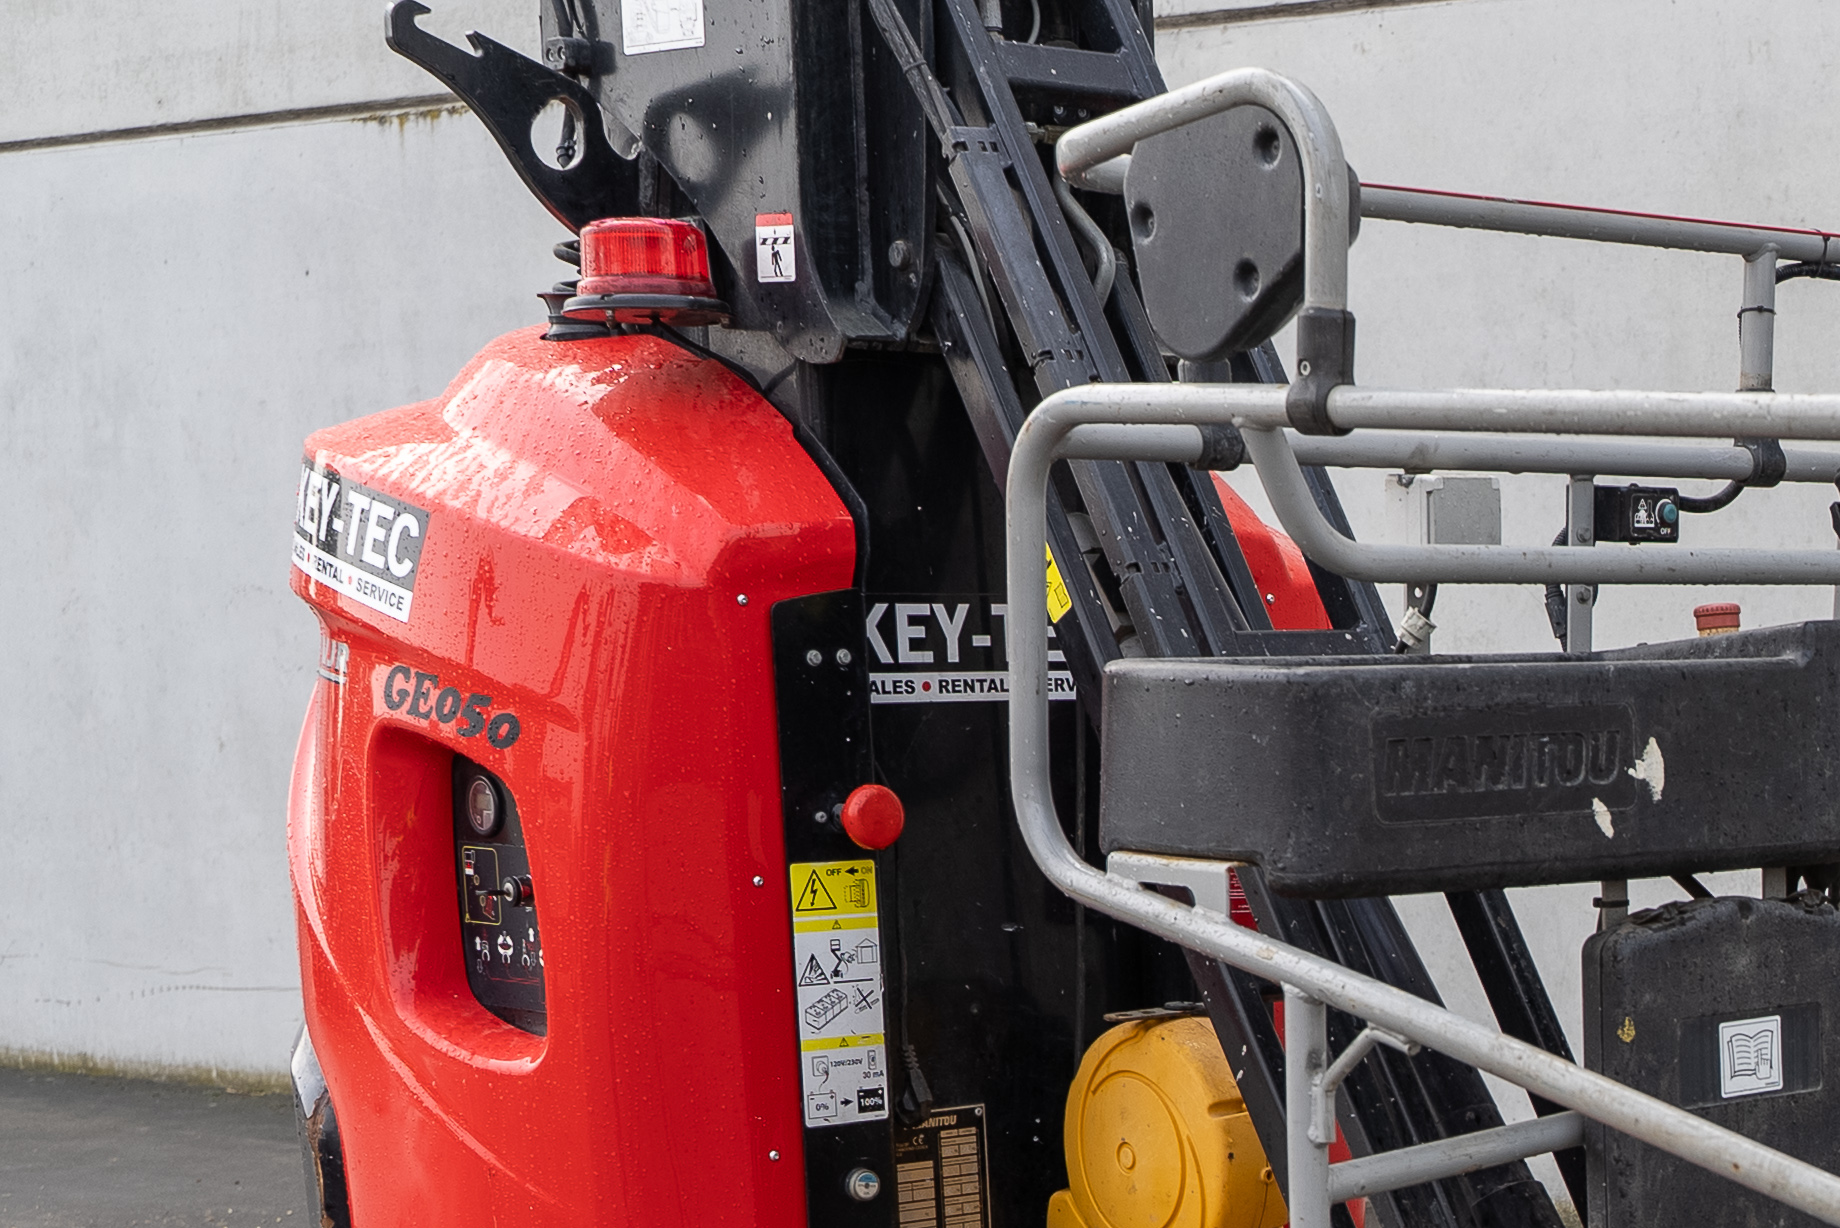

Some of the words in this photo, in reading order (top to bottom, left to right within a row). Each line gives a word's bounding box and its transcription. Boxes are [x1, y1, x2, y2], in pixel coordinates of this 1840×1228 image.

[1660, 527, 1671, 535] OFF
[355, 577, 405, 611] SERVICE
[870, 679, 916, 695] ALES
[938, 677, 1010, 694] RENTAL
[1383, 729, 1621, 797] MANITOU
[826, 868, 842, 876] OFF
[861, 866, 873, 874] ON
[862, 1071, 871, 1079] 30
[815, 1103, 829, 1111] 0%
[860, 1097, 883, 1107] 100%
[912, 1115, 957, 1129] ANITOU
